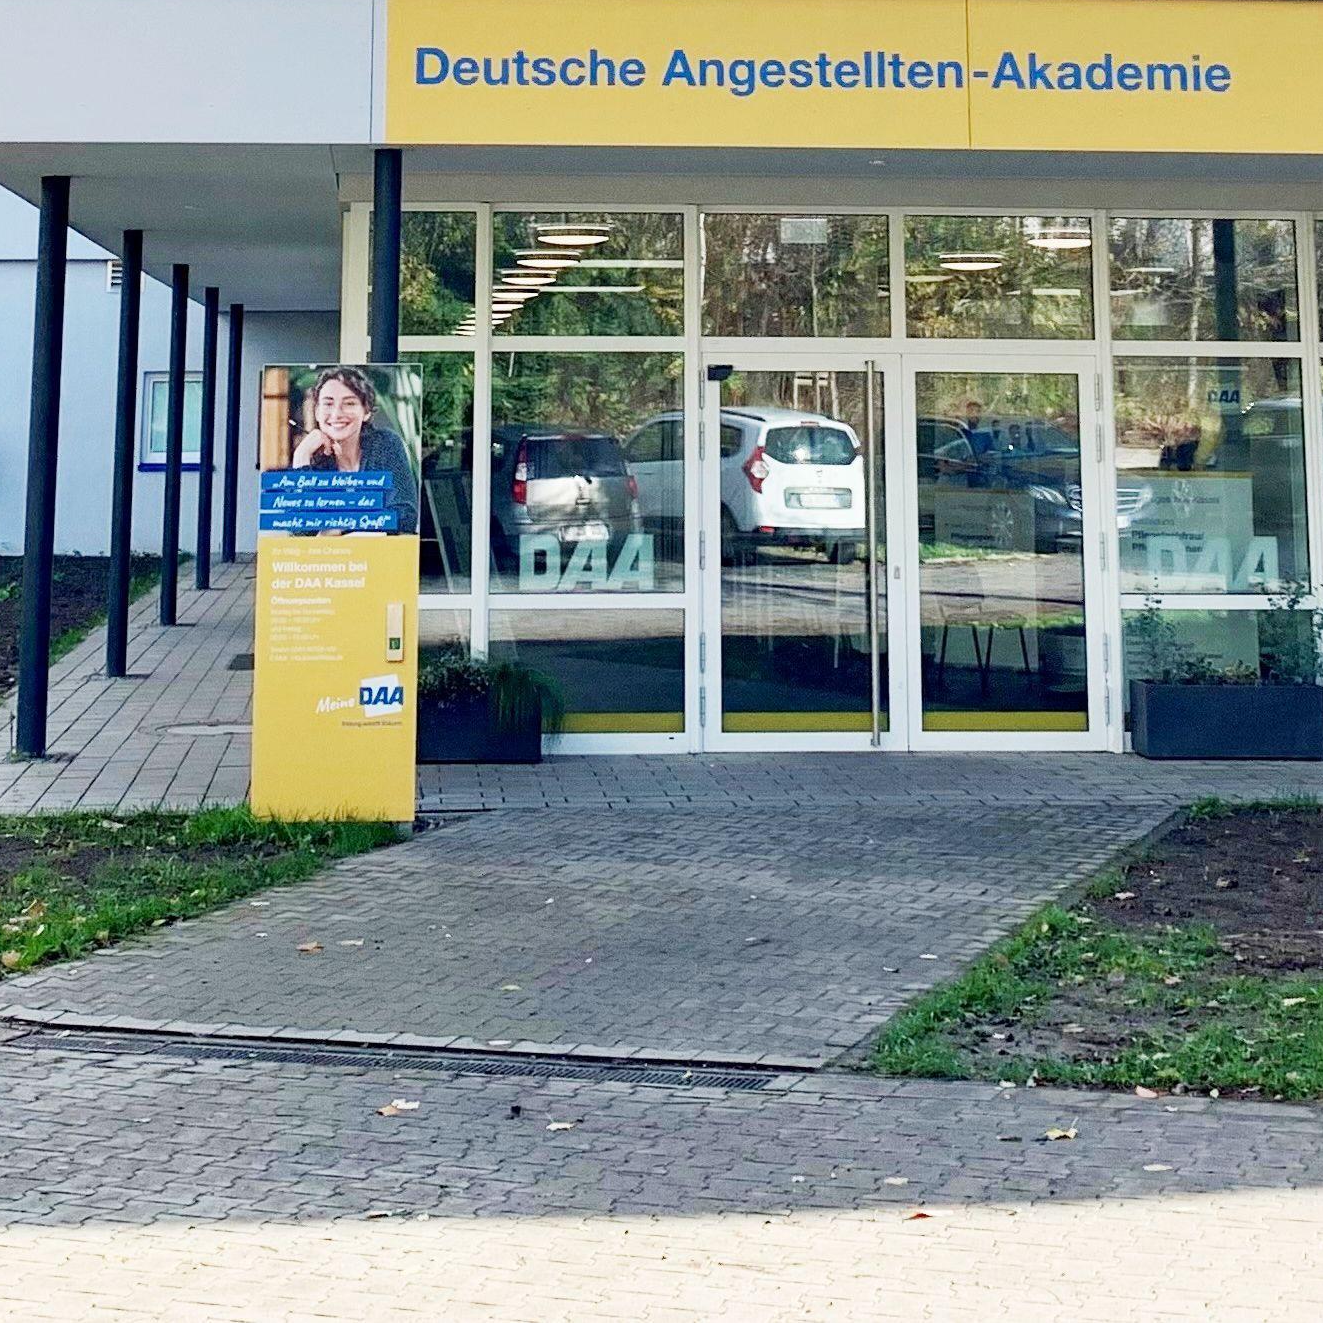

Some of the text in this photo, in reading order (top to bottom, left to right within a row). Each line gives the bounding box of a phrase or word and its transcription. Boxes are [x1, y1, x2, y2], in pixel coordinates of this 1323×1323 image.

[416, 48, 1231, 96] Deutsche Angestellten-Akademie
[297, 475, 318, 488] Ball
[331, 475, 364, 487] bleiben
[366, 475, 385, 487] und
[272, 496, 302, 508] Neues
[316, 496, 346, 507] lernen
[272, 560, 368, 573] Willkommen bei
[519, 534, 655, 592] DAA
[1147, 536, 1280, 592] DAA
[271, 577, 366, 590] der DAA Kassel
[315, 686, 404, 715] Meine DAA
